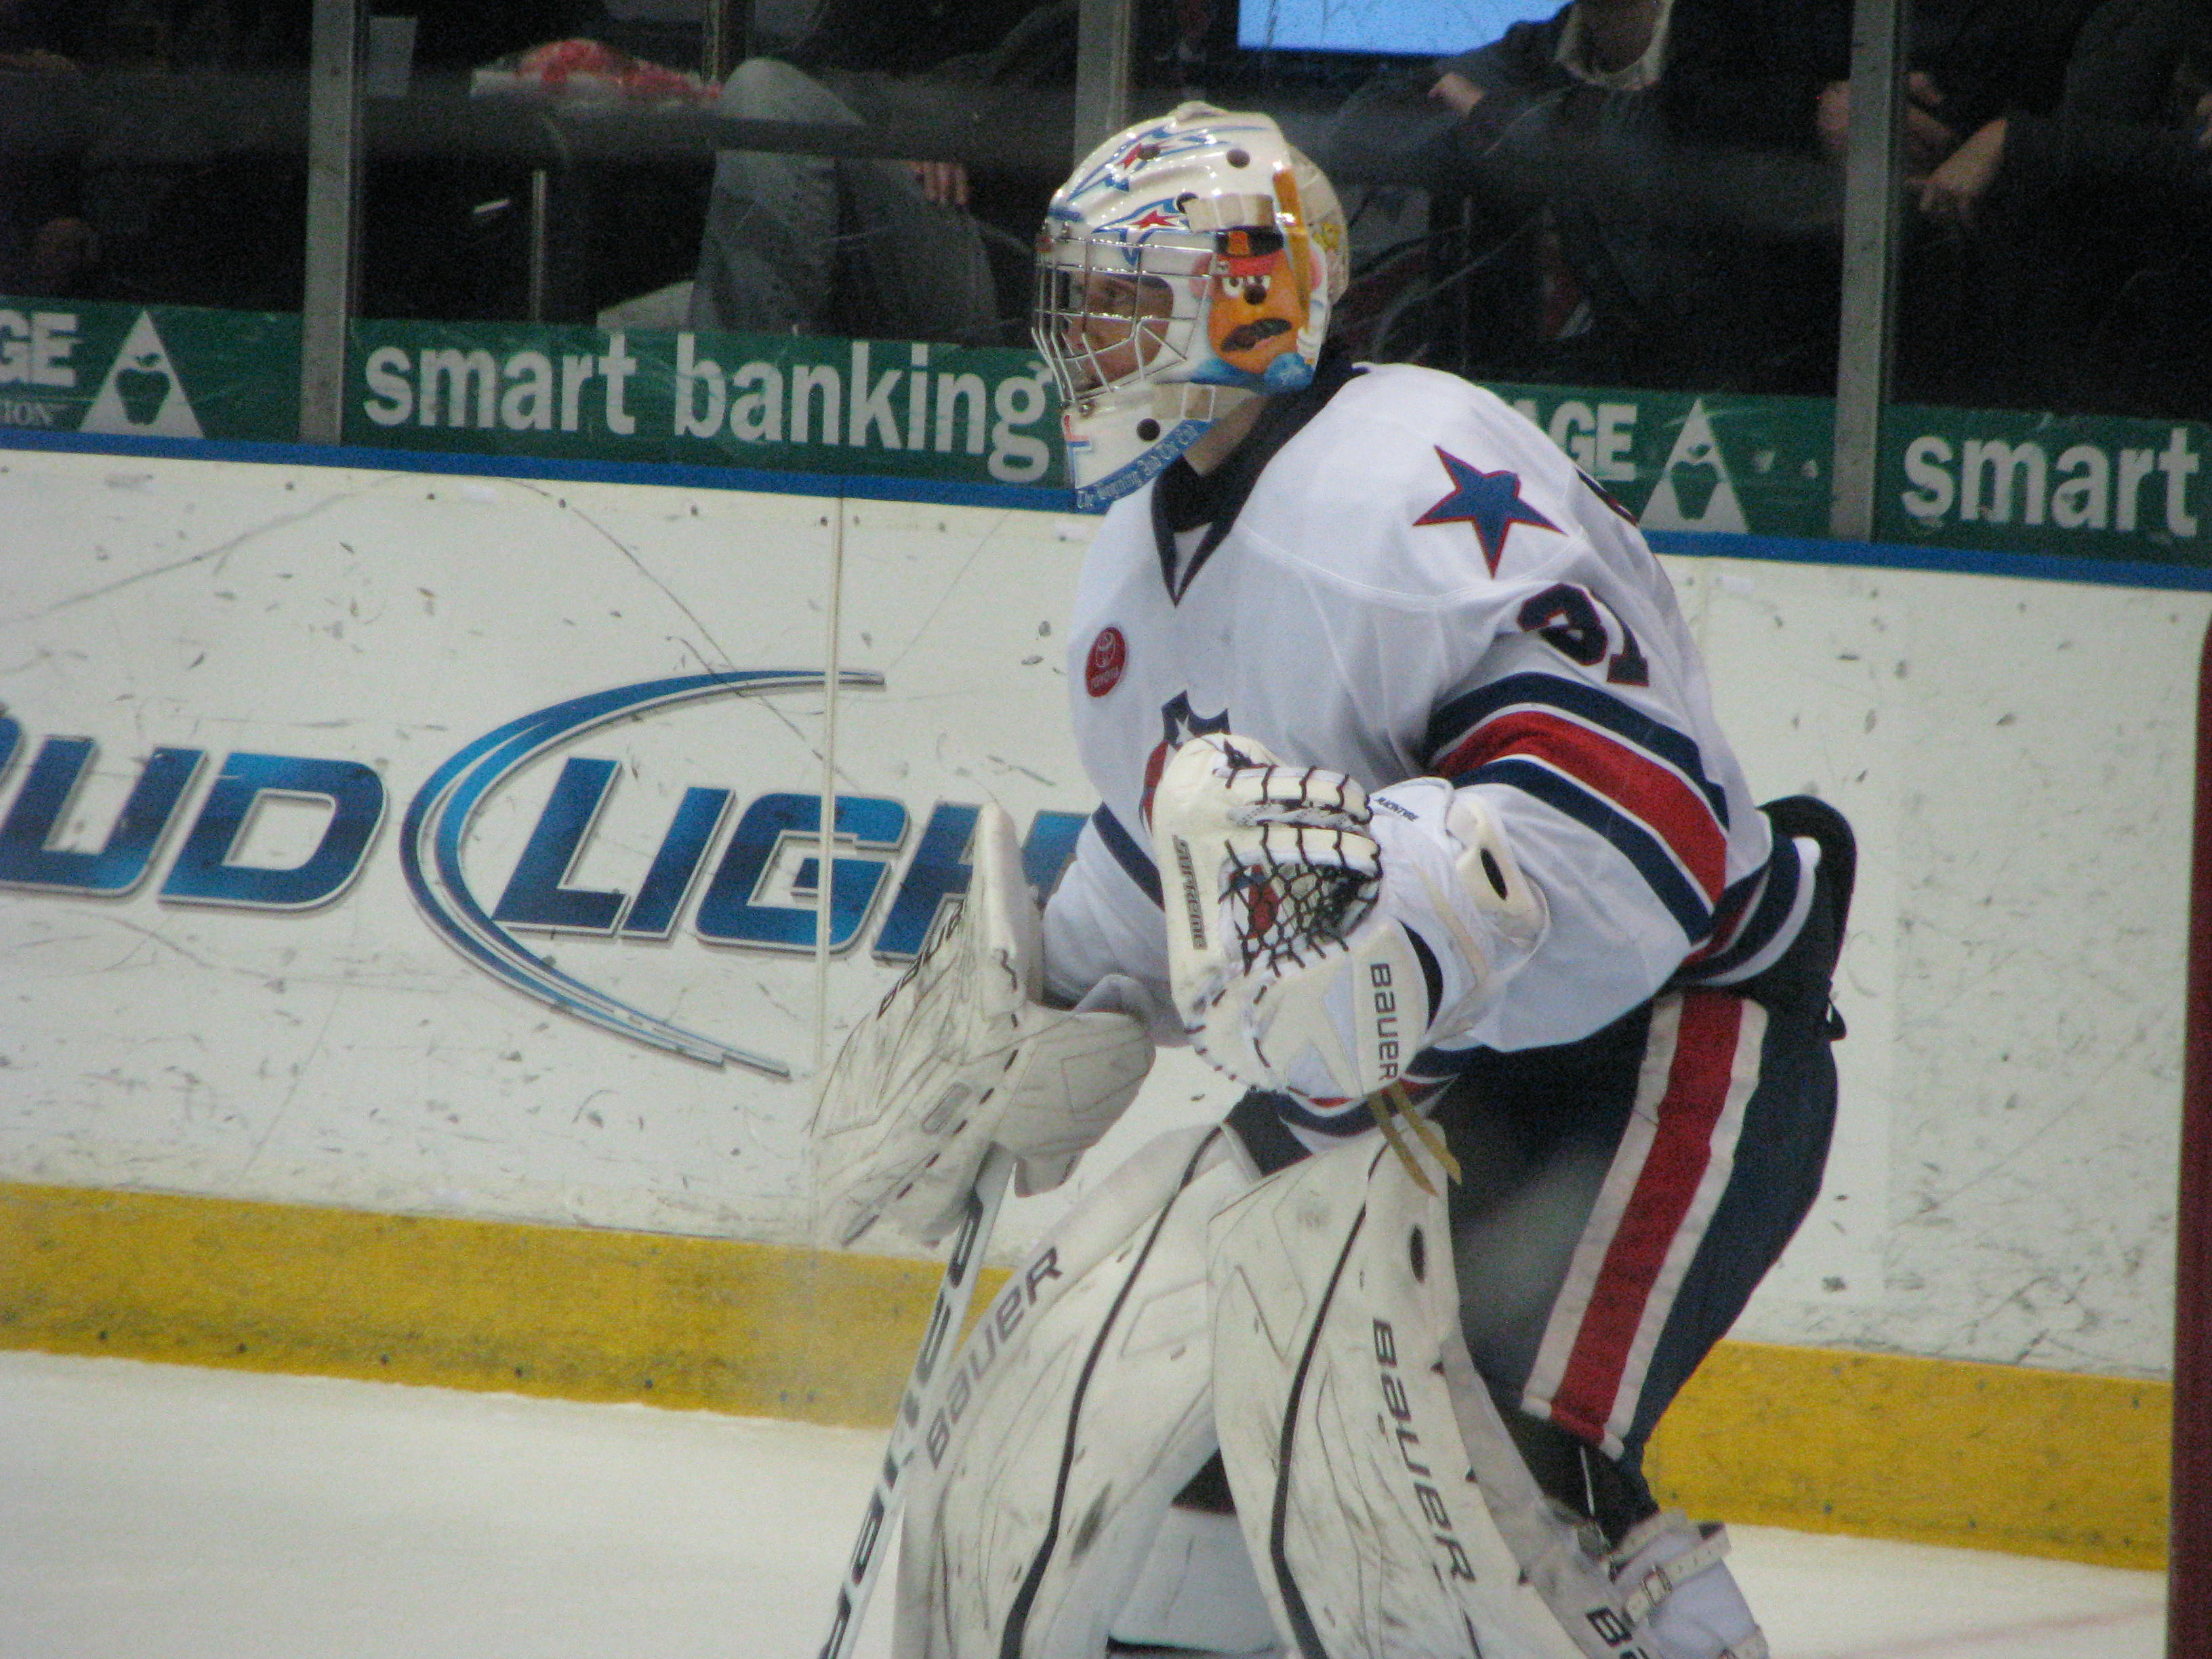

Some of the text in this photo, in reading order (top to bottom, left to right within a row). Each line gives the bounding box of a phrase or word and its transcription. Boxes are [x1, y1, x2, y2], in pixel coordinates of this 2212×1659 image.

[363, 332, 1052, 483] smart banking
[1513, 399, 1638, 482] GE
[1900, 427, 2199, 538] smart
[0, 715, 388, 912] UD
